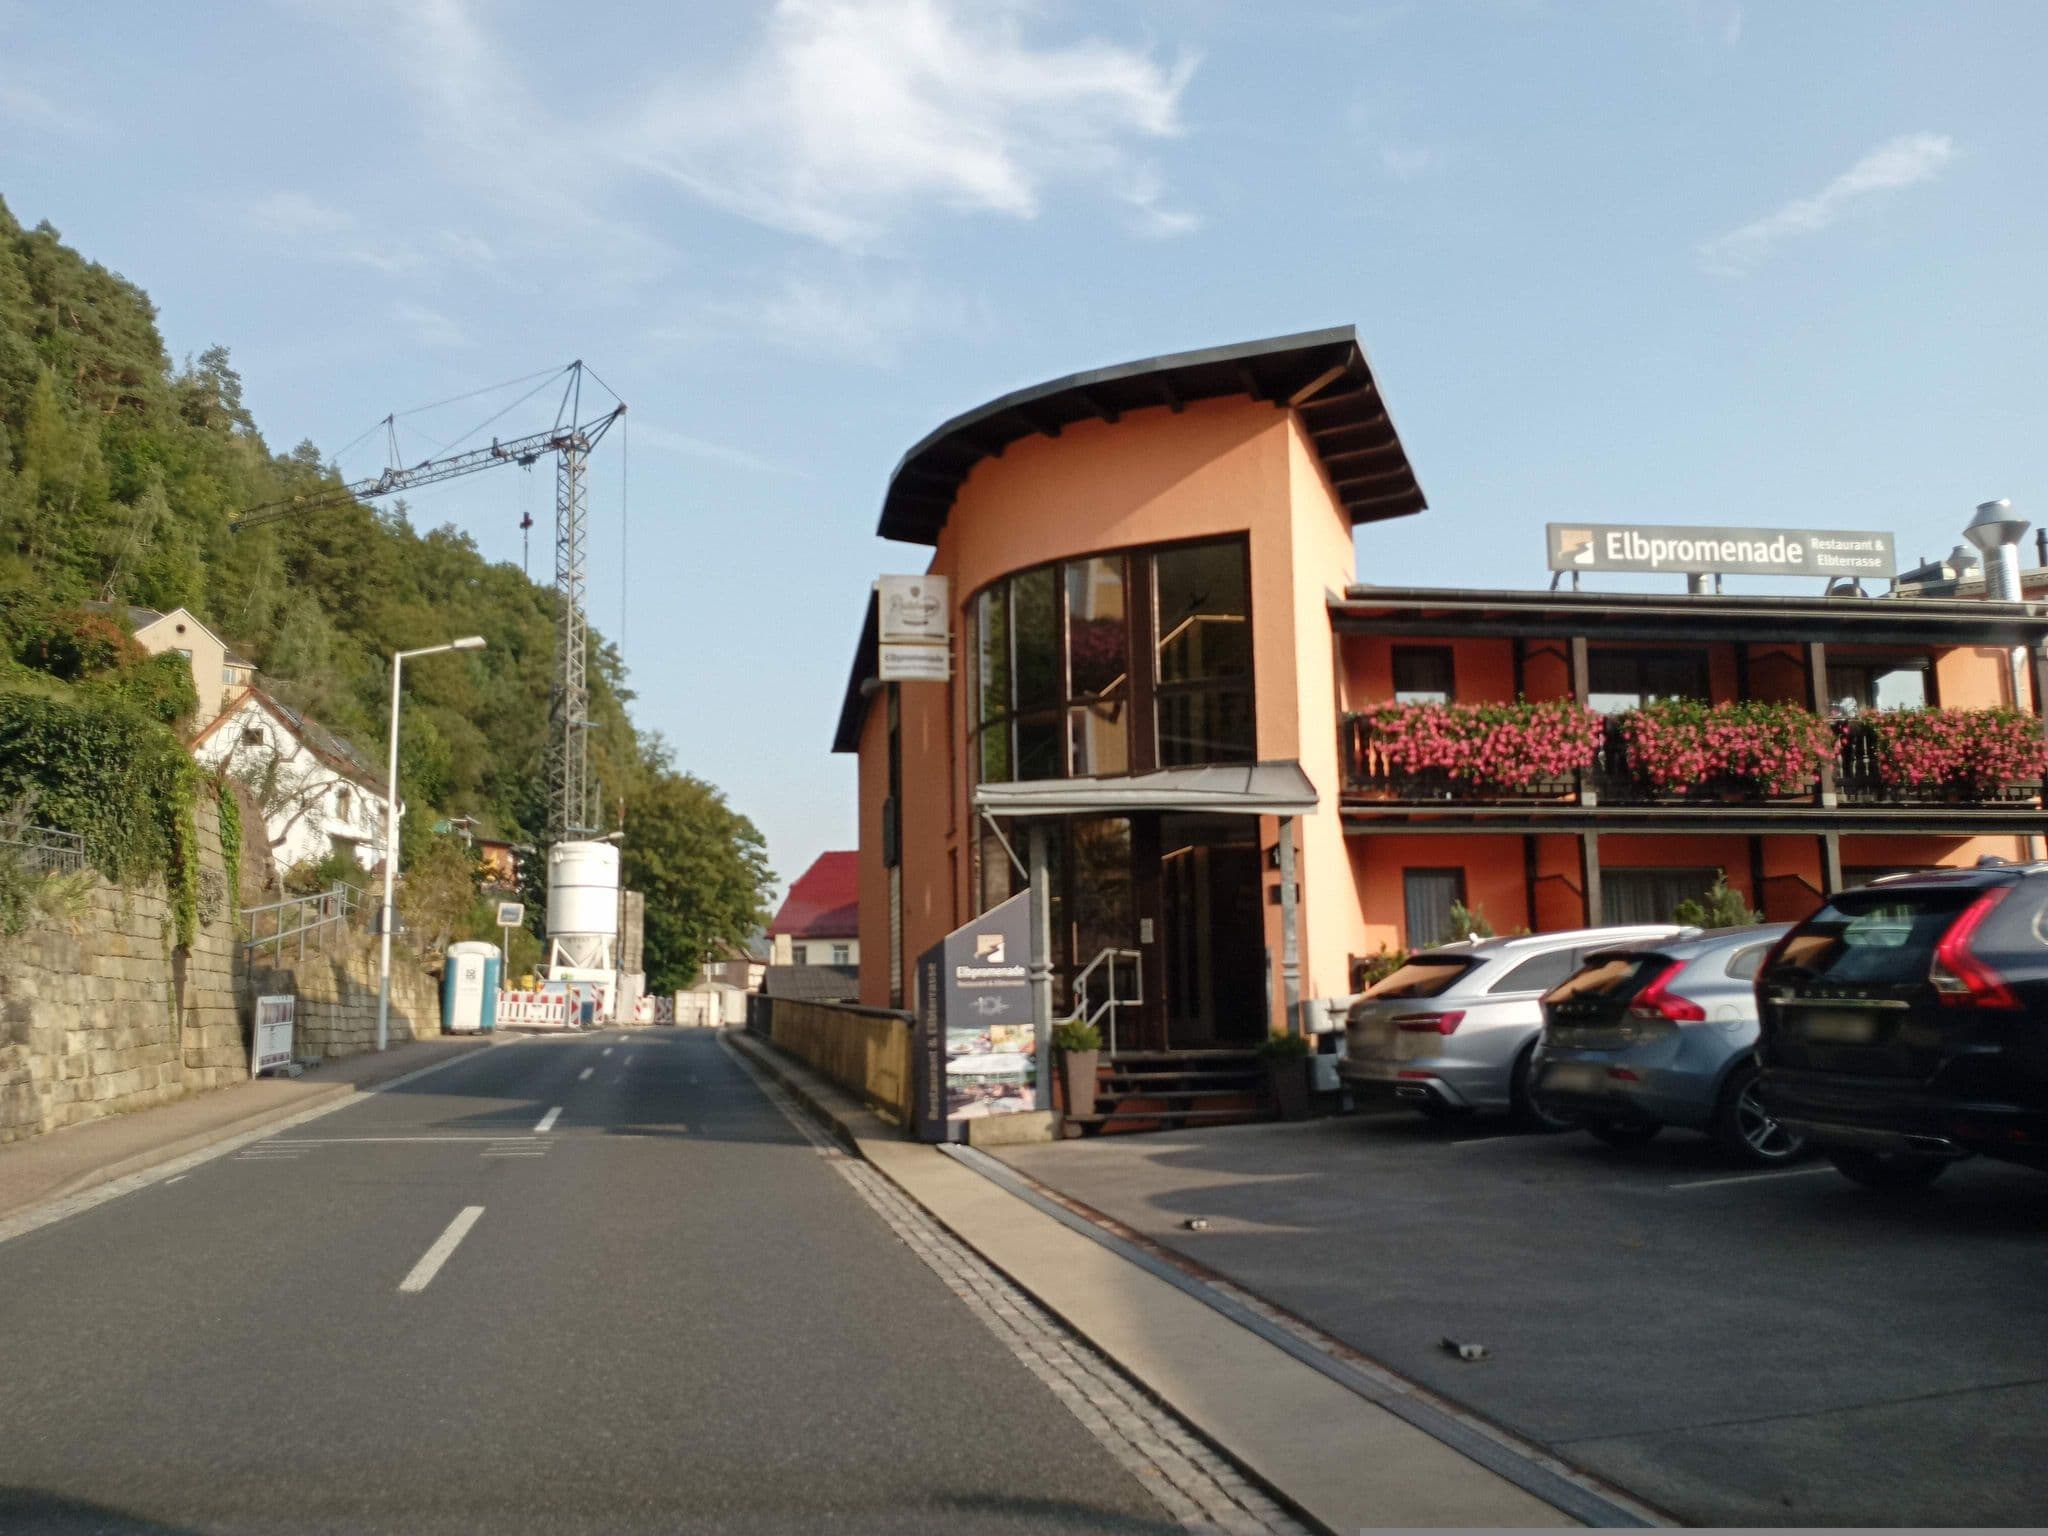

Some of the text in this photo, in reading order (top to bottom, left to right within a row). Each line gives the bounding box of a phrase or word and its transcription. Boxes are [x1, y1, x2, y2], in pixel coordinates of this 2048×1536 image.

[1606, 531, 1803, 567] Elbpromenade
[1810, 537, 1884, 551] Restaurant &
[1816, 553, 1882, 567] Elbterrasse
